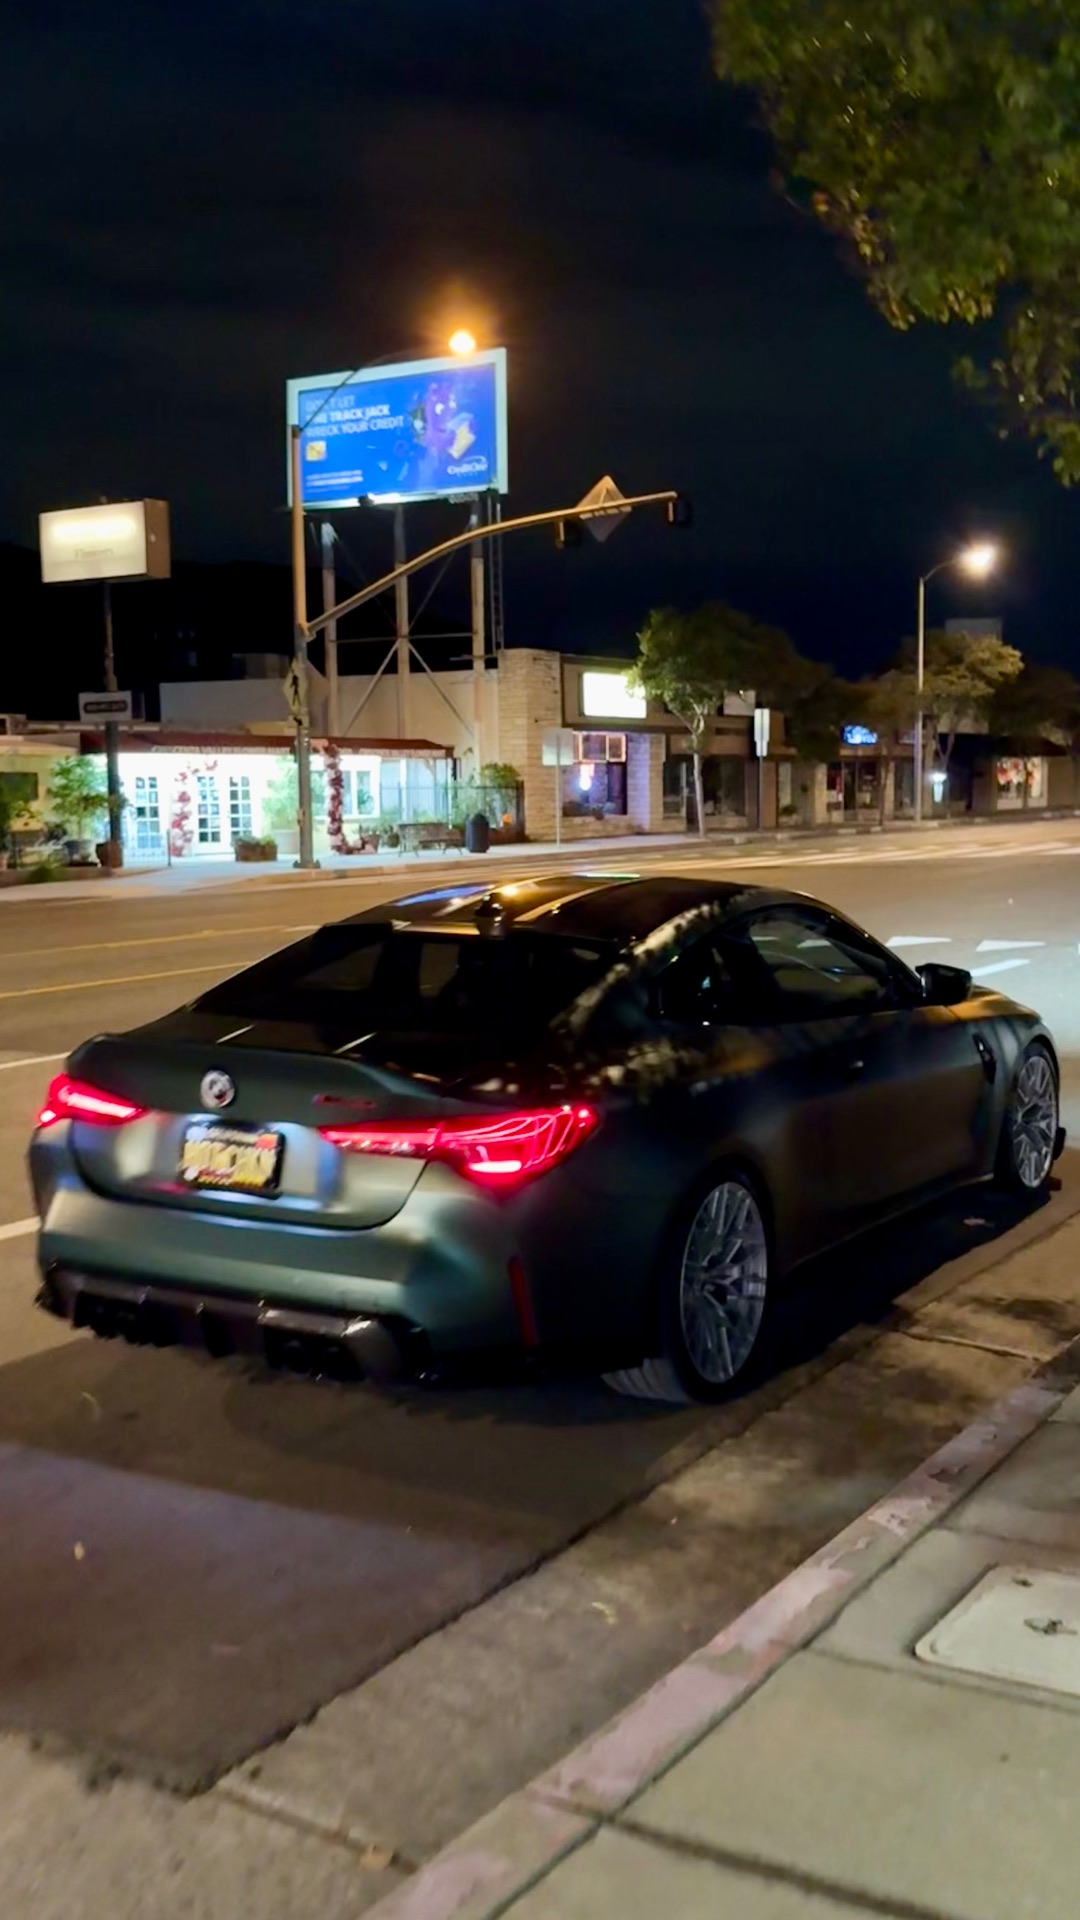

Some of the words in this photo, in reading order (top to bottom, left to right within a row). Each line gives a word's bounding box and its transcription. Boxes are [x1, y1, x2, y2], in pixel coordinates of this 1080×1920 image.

[330, 407, 363, 422] TRACK
[364, 404, 390, 420] JACK
[340, 420, 369, 434] YOUR
[369, 415, 405, 431] CREDIT
